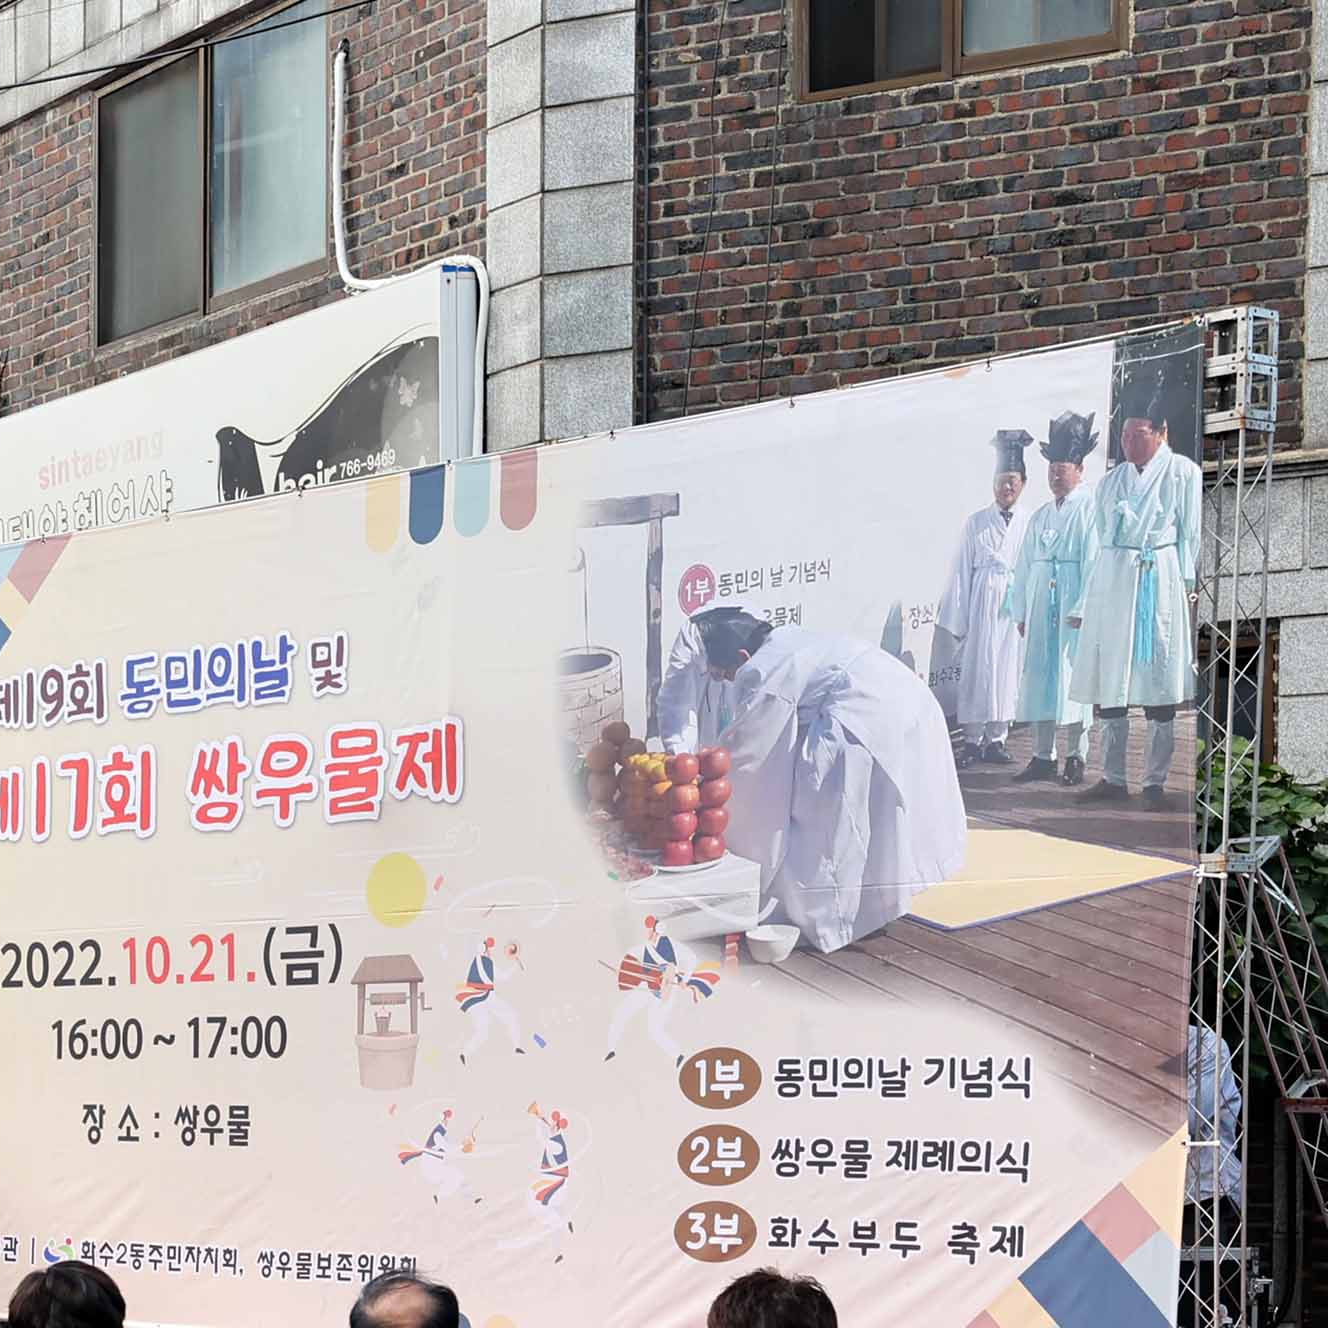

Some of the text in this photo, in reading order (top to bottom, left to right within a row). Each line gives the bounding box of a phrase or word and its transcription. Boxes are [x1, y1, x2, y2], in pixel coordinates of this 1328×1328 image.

[37, 430, 164, 491] sintaeyang
[339, 448, 396, 479] 766-9469
[685, 558, 832, 603] 1부 동민의 날 기념식
[120, 634, 295, 715] 동민의날
[310, 634, 345, 693] 및
[189, 722, 459, 823] 쌍우물제
[50, 1018, 144, 1060] 16:00
[187, 1015, 288, 1059] 17:00
[694, 1055, 1032, 1100] 1부 동민의날 기념식
[173, 1104, 251, 1147] 쌍우물
[689, 1135, 1031, 1183] 2부 쌍우물 제례의식
[81, 1240, 244, 1277] 화수2동주민자치회,
[685, 1211, 743, 1254] 3부
[946, 1221, 1025, 1265] 축제
